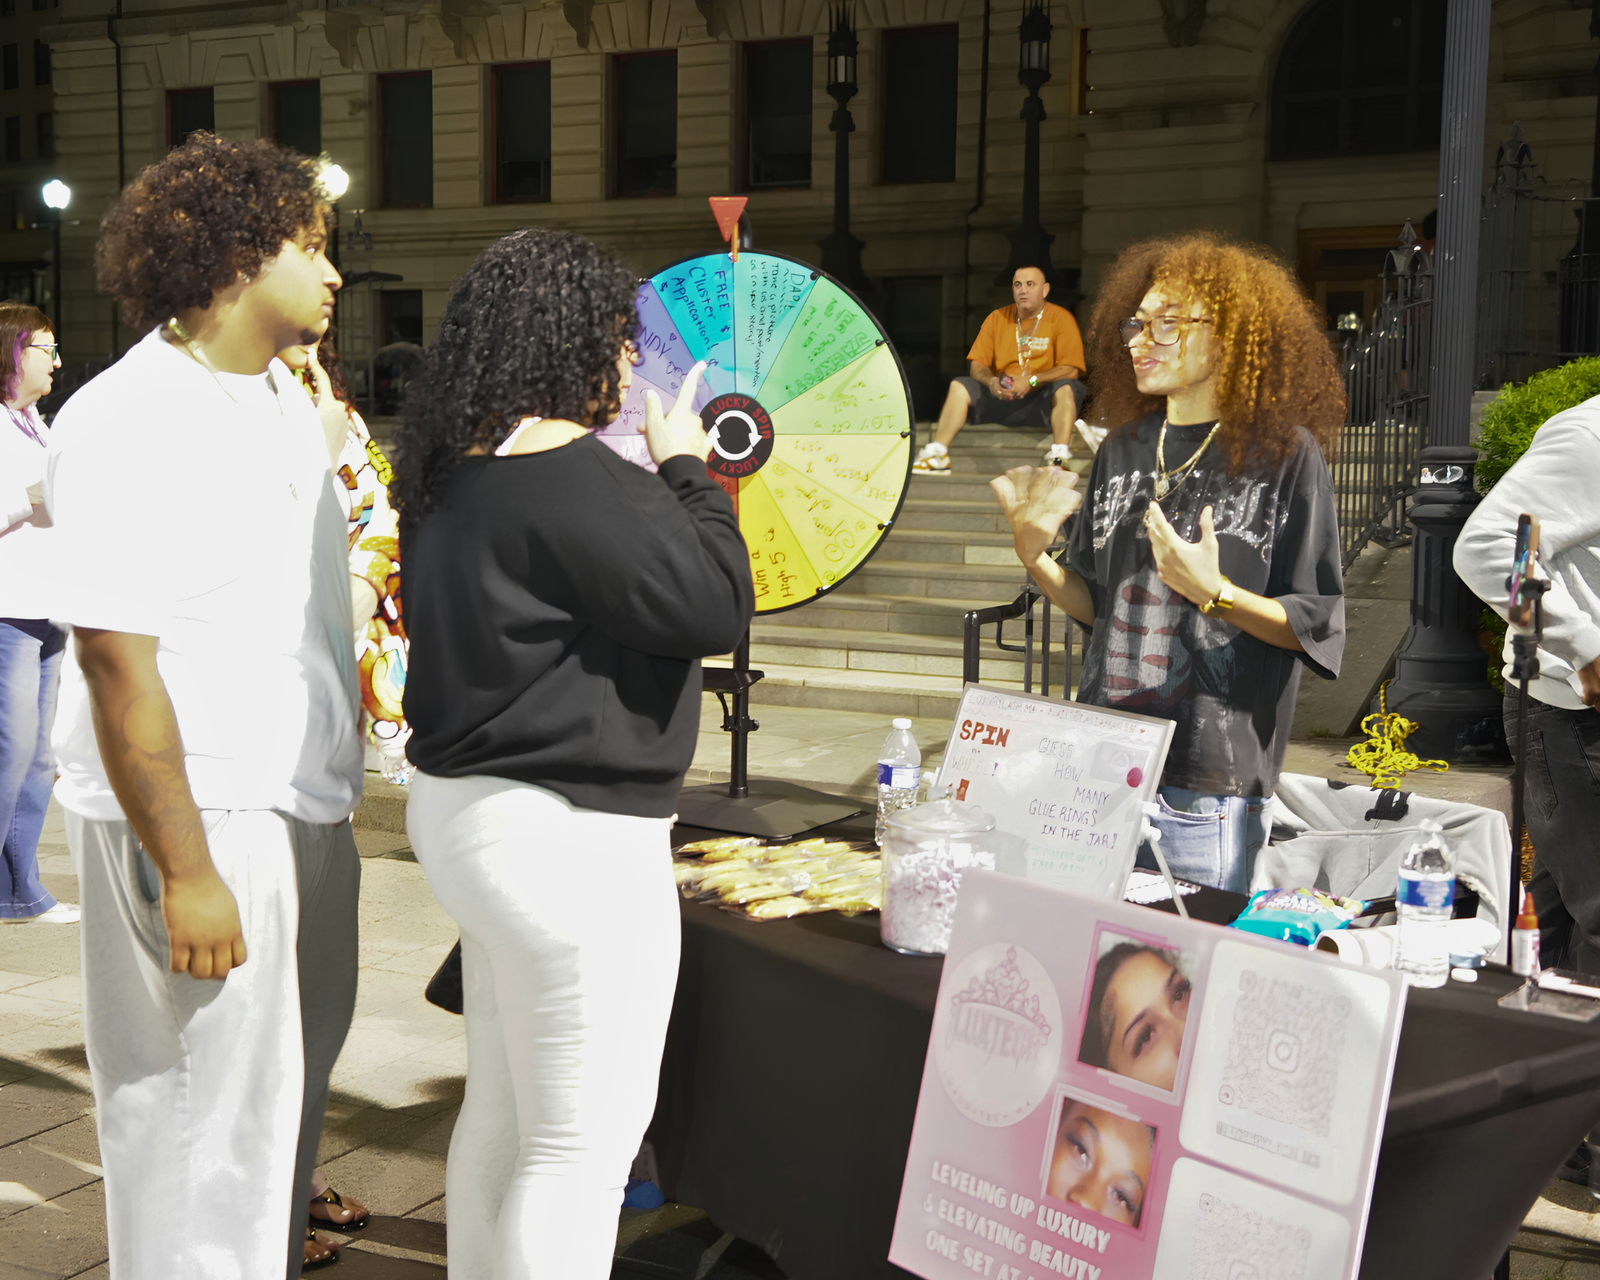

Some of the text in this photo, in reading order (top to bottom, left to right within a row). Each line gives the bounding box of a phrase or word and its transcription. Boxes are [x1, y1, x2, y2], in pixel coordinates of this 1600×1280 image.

[689, 266, 717, 320] Cluster
[711, 270, 731, 312] FREE
[670, 276, 720, 350] Application!
[638, 326, 673, 360] NDY
[710, 397, 772, 440] LUCKY SPIN
[718, 456, 759, 474] LUCKY
[751, 549, 770, 599] Win a
[768, 551, 798, 599] High 5
[959, 719, 1011, 748] SPIN
[1038, 737, 1075, 760] GUESS
[1053, 762, 1084, 783] HOW
[1028, 798, 1098, 828] GLUE RINGS
[1072, 786, 1111, 806] MANY
[1040, 824, 1119, 850] IN THE JAR!
[930, 1160, 1112, 1256] LEVELING UP LUXURY
[924, 1229, 1023, 1280] ONE SET AT
[936, 1198, 1027, 1256] ELEVATING
[1027, 1238, 1102, 1280] BEAUTY
